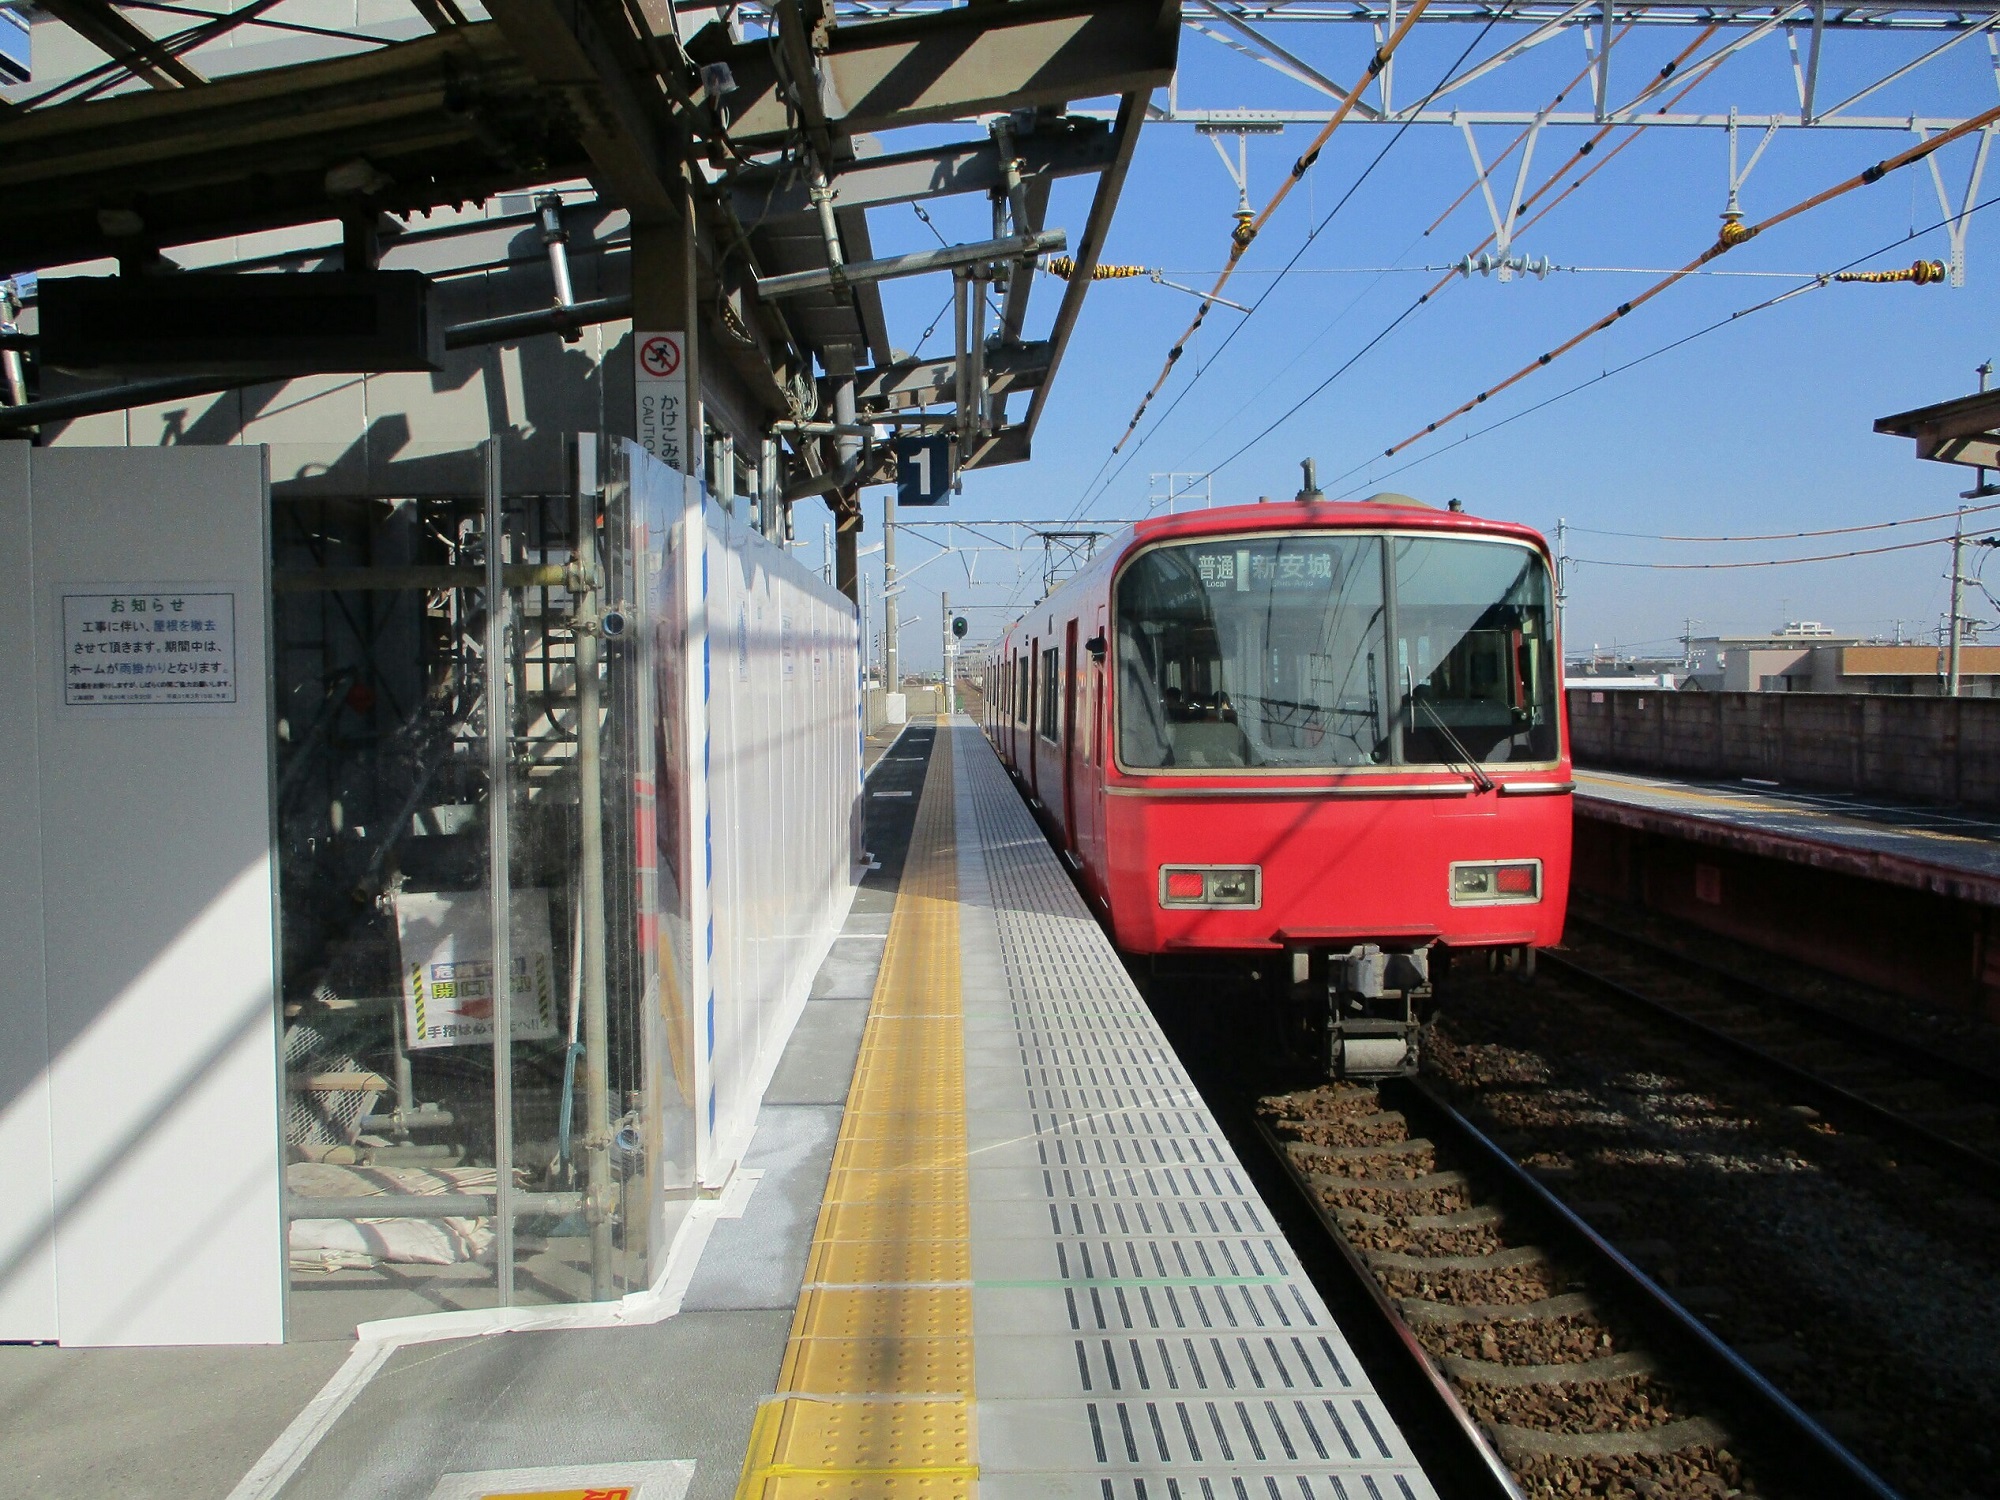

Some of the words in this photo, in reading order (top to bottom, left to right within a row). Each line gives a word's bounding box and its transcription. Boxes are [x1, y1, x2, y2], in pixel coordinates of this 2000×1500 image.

[908, 447, 932, 495] 1
[1198, 555, 1234, 580] 普通
[1252, 553, 1332, 579] 新安城
[111, 598, 185, 613] お知らせ
[82, 619, 216, 633] 工事に伴い、屋根を撤去
[74, 641, 223, 654] させて頂きます。期間中は、
